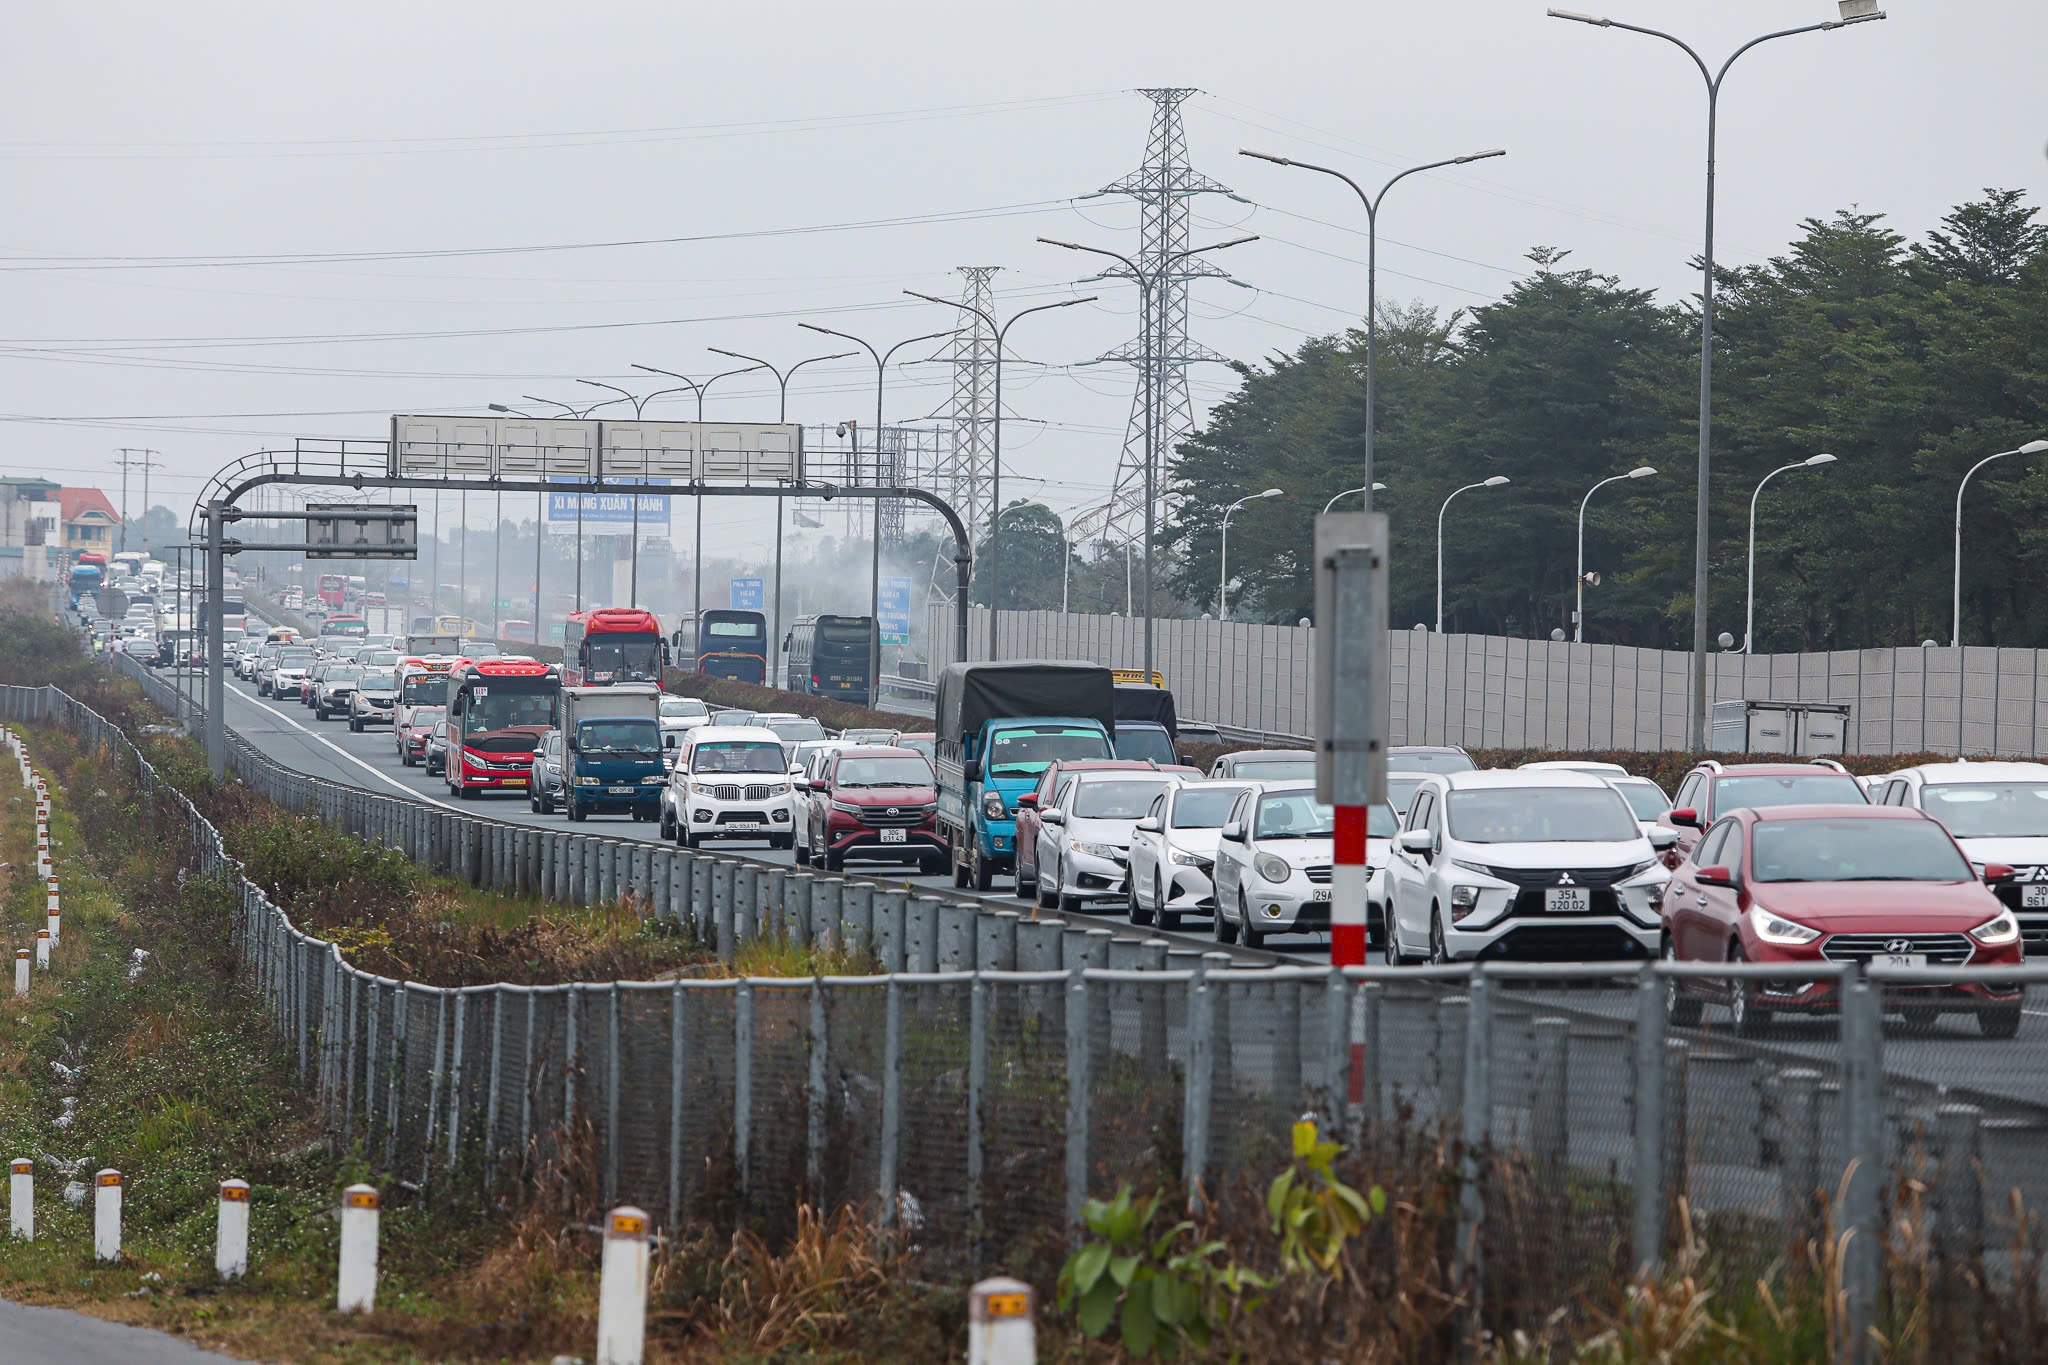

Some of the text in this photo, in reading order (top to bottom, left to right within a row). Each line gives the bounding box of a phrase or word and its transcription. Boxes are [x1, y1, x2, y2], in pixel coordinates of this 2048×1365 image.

[554, 496, 564, 509] XI
[1558, 890, 1577, 900] 35A
[1550, 900, 1586, 910] 320.02
